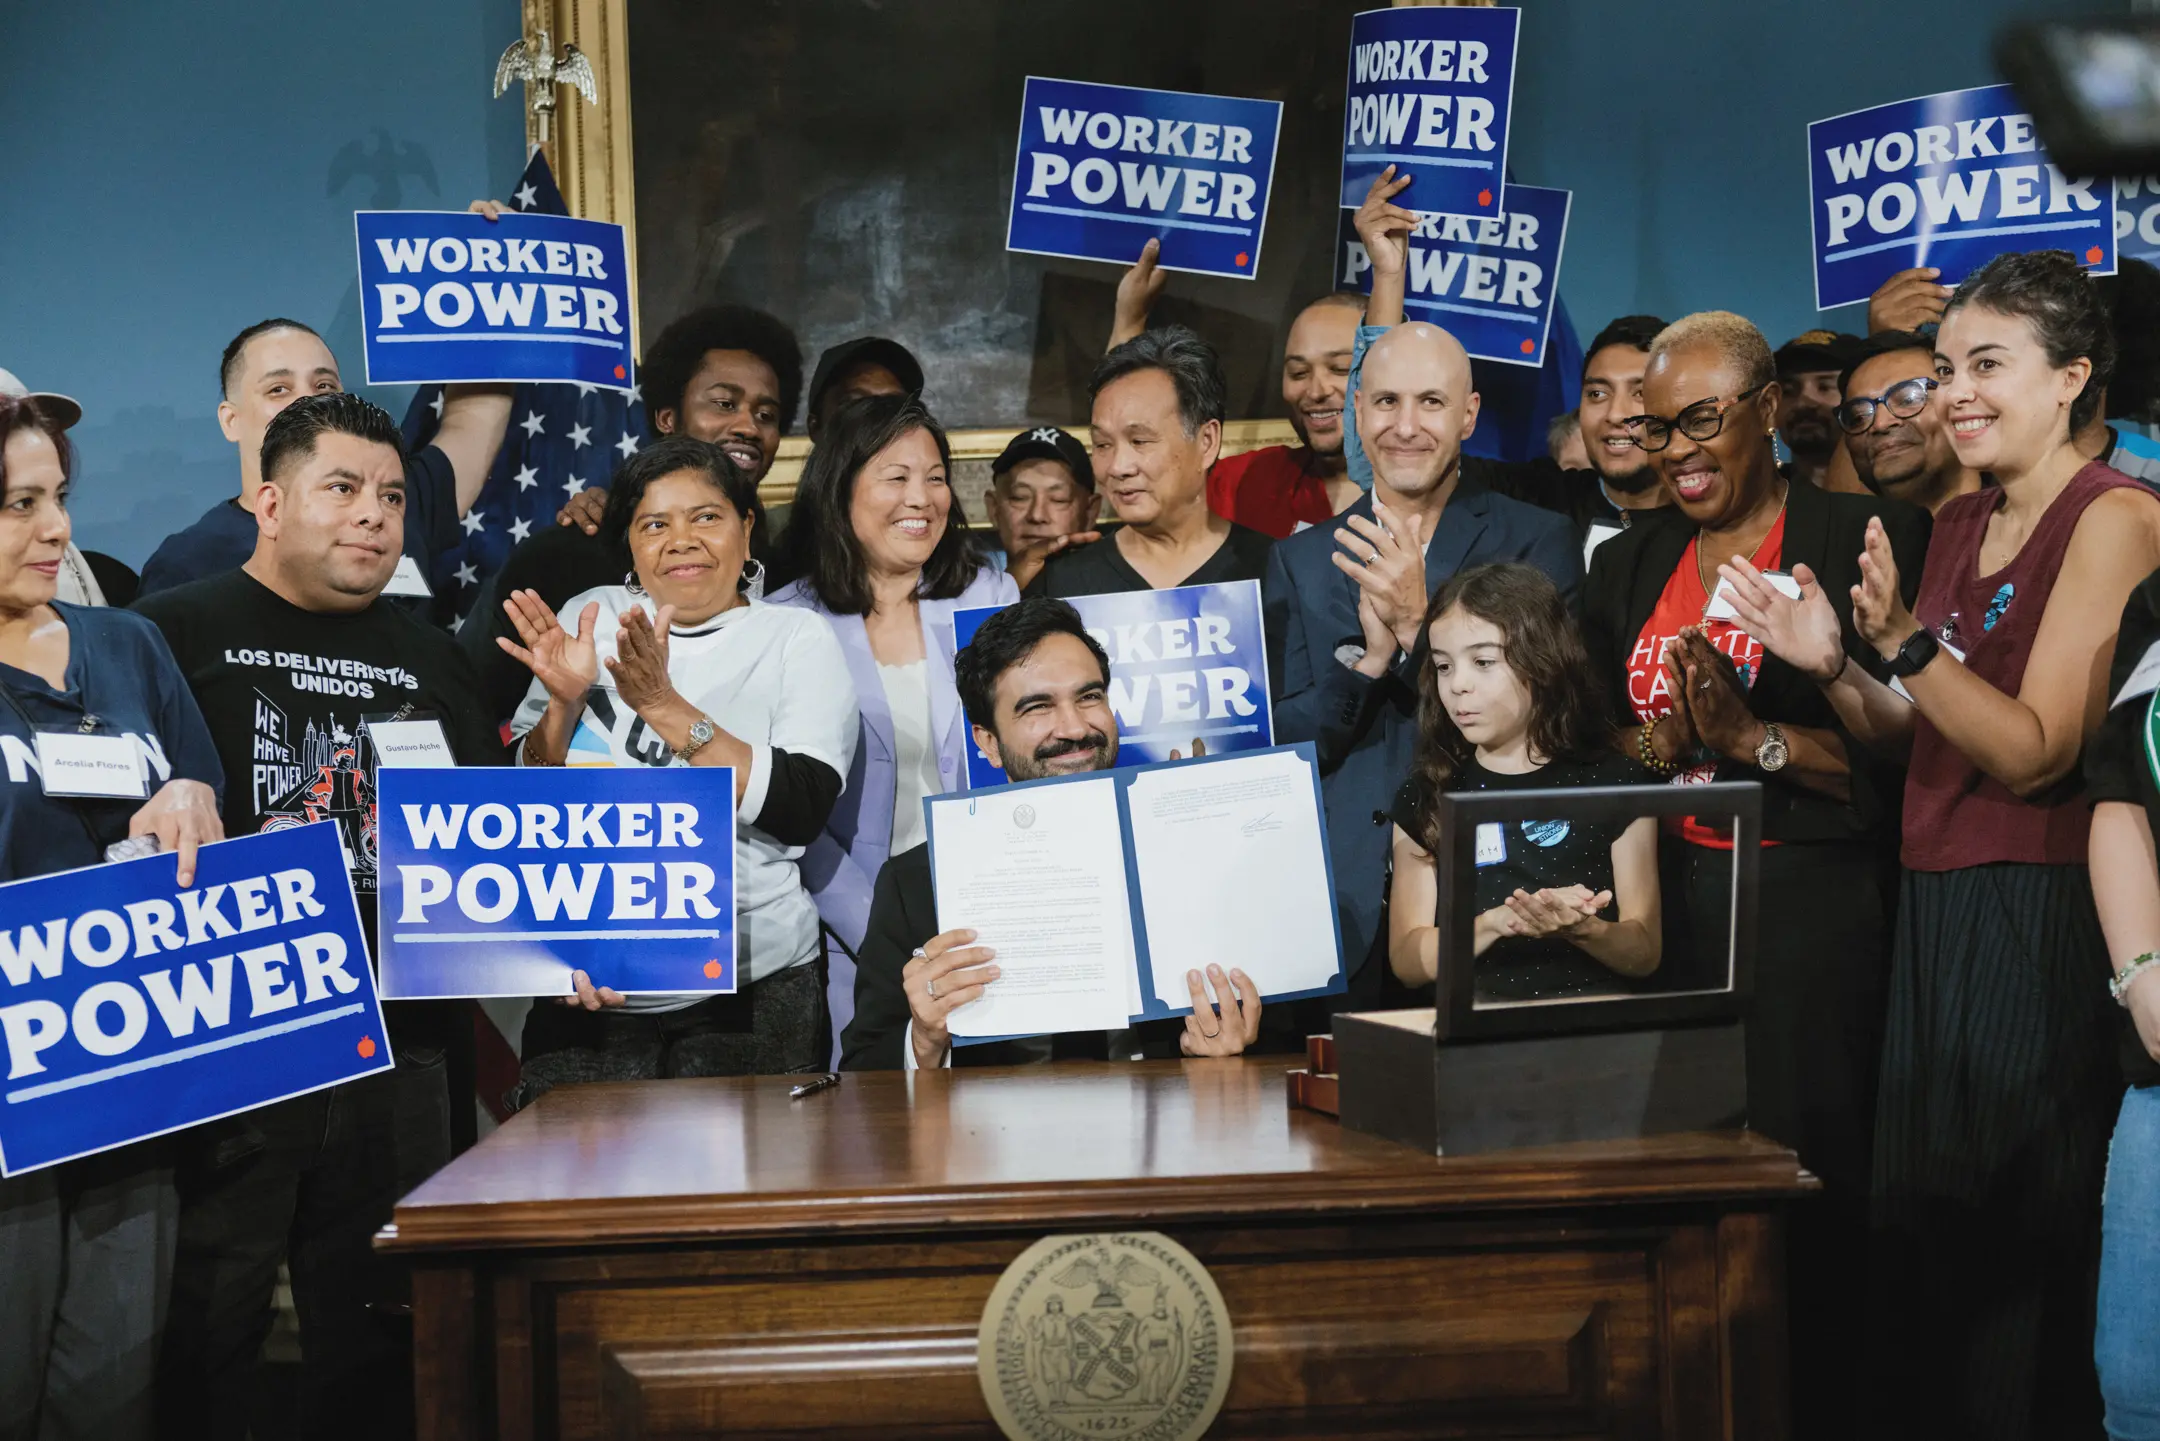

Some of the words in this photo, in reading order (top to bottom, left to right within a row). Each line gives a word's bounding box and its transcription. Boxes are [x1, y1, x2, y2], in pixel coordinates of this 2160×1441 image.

[1355, 39, 1489, 84] WORKER
[1039, 106, 1252, 164] WORKER
[1348, 93, 1496, 152] POWER
[1825, 113, 2046, 184] WORKE
[1026, 152, 1256, 221] POWER
[1409, 212, 1540, 251] RKER
[375, 236, 608, 280] WORKER
[1343, 240, 1543, 308] PWER
[375, 281, 623, 335] POWER
[224, 649, 271, 667] LOS
[291, 672, 375, 699] UNIDOS
[1108, 666, 1257, 727] WER
[254, 698, 280, 741] WE
[54, 758, 94, 768] Arcelia
[96, 760, 131, 770] Flores
[254, 734, 290, 763] HAVE
[253, 764, 302, 816] POWER
[400, 802, 703, 850] WORKER
[1534, 823, 1555, 833] UNION
[1538, 824, 1563, 842] STRONG
[396, 861, 721, 924] POWER
[0, 868, 326, 987] WORKER
[0, 932, 360, 1080] POWER
[1087, 1416, 1129, 1430] 1625
